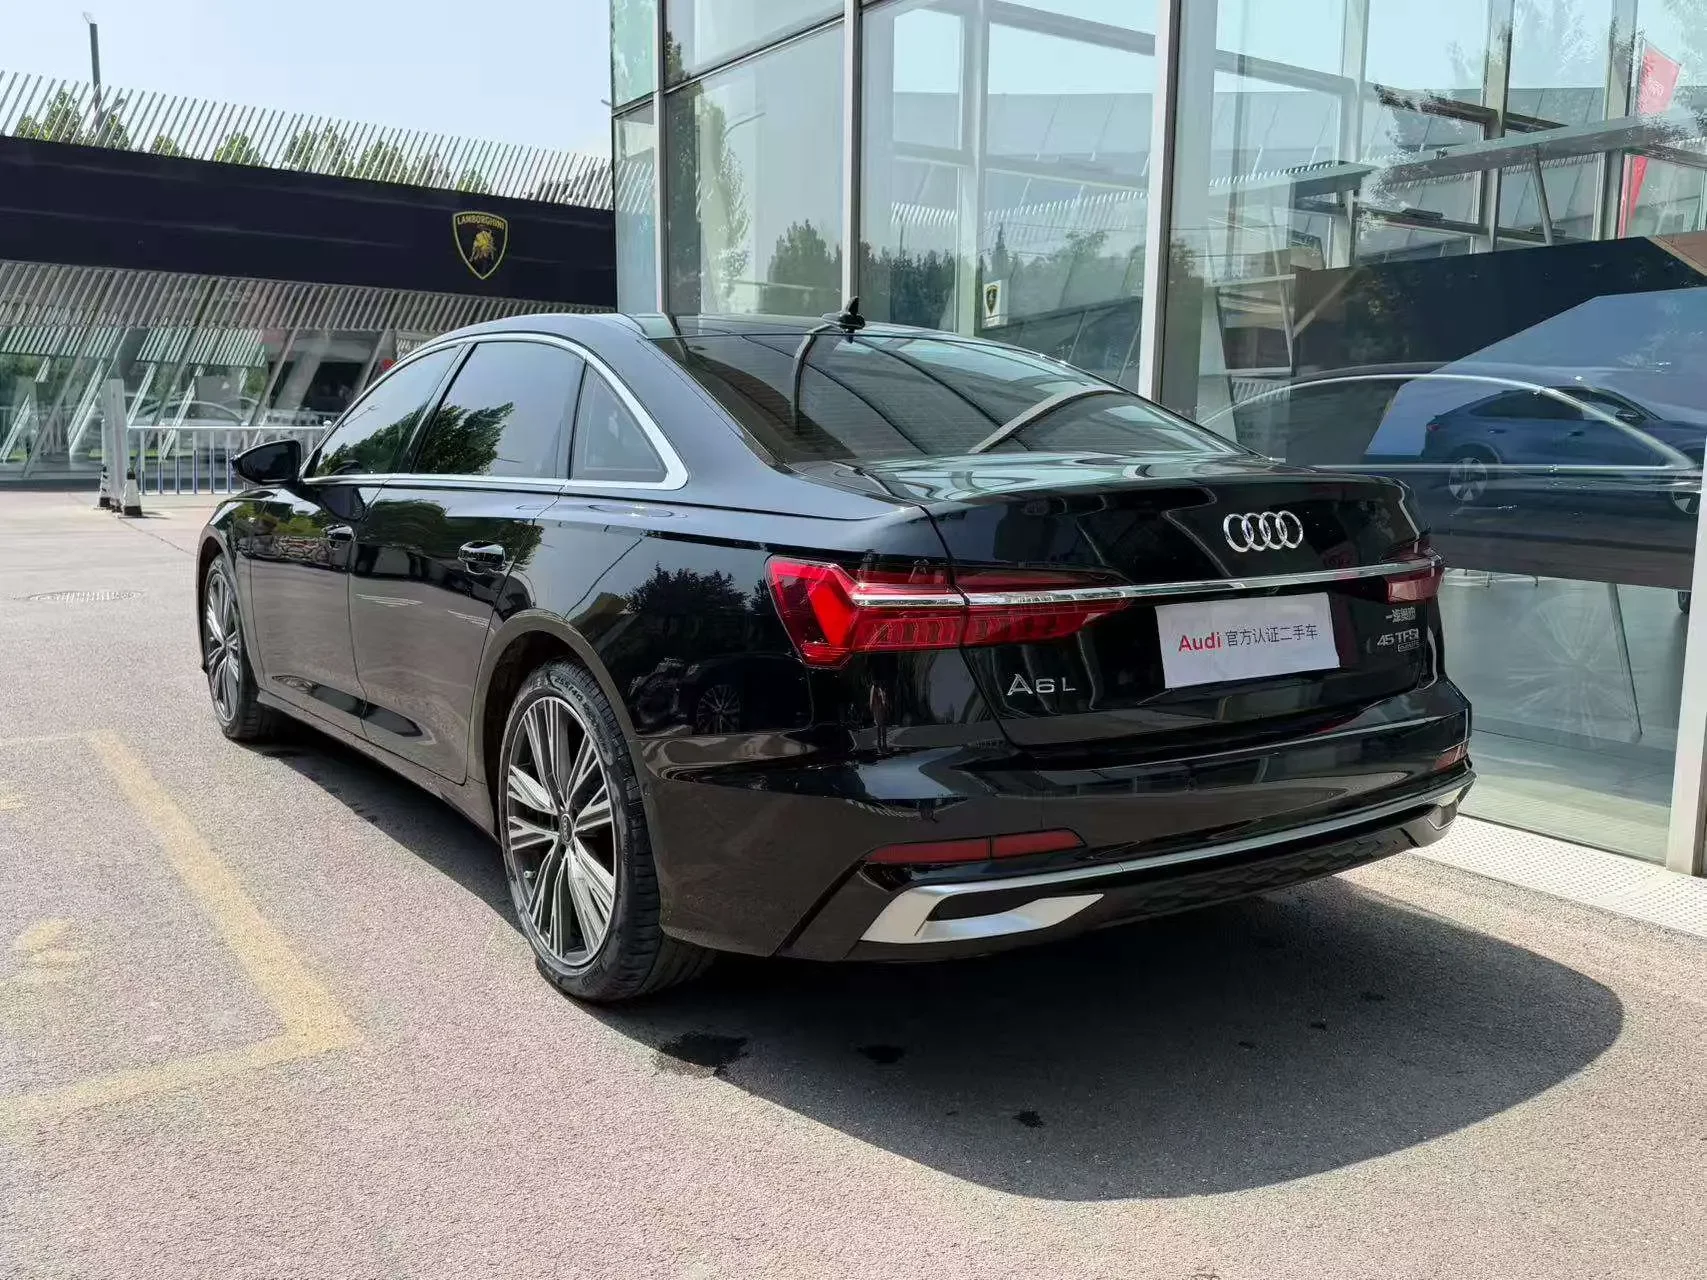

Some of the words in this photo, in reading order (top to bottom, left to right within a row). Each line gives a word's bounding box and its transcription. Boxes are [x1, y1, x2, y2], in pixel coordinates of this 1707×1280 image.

[457, 215, 504, 230] LAMBORGHINI
[1178, 631, 1222, 652] Audi
[1225, 624, 1318, 647] 官方认证二手车
[1377, 634, 1394, 646] 45
[1395, 628, 1419, 643] TFSI
